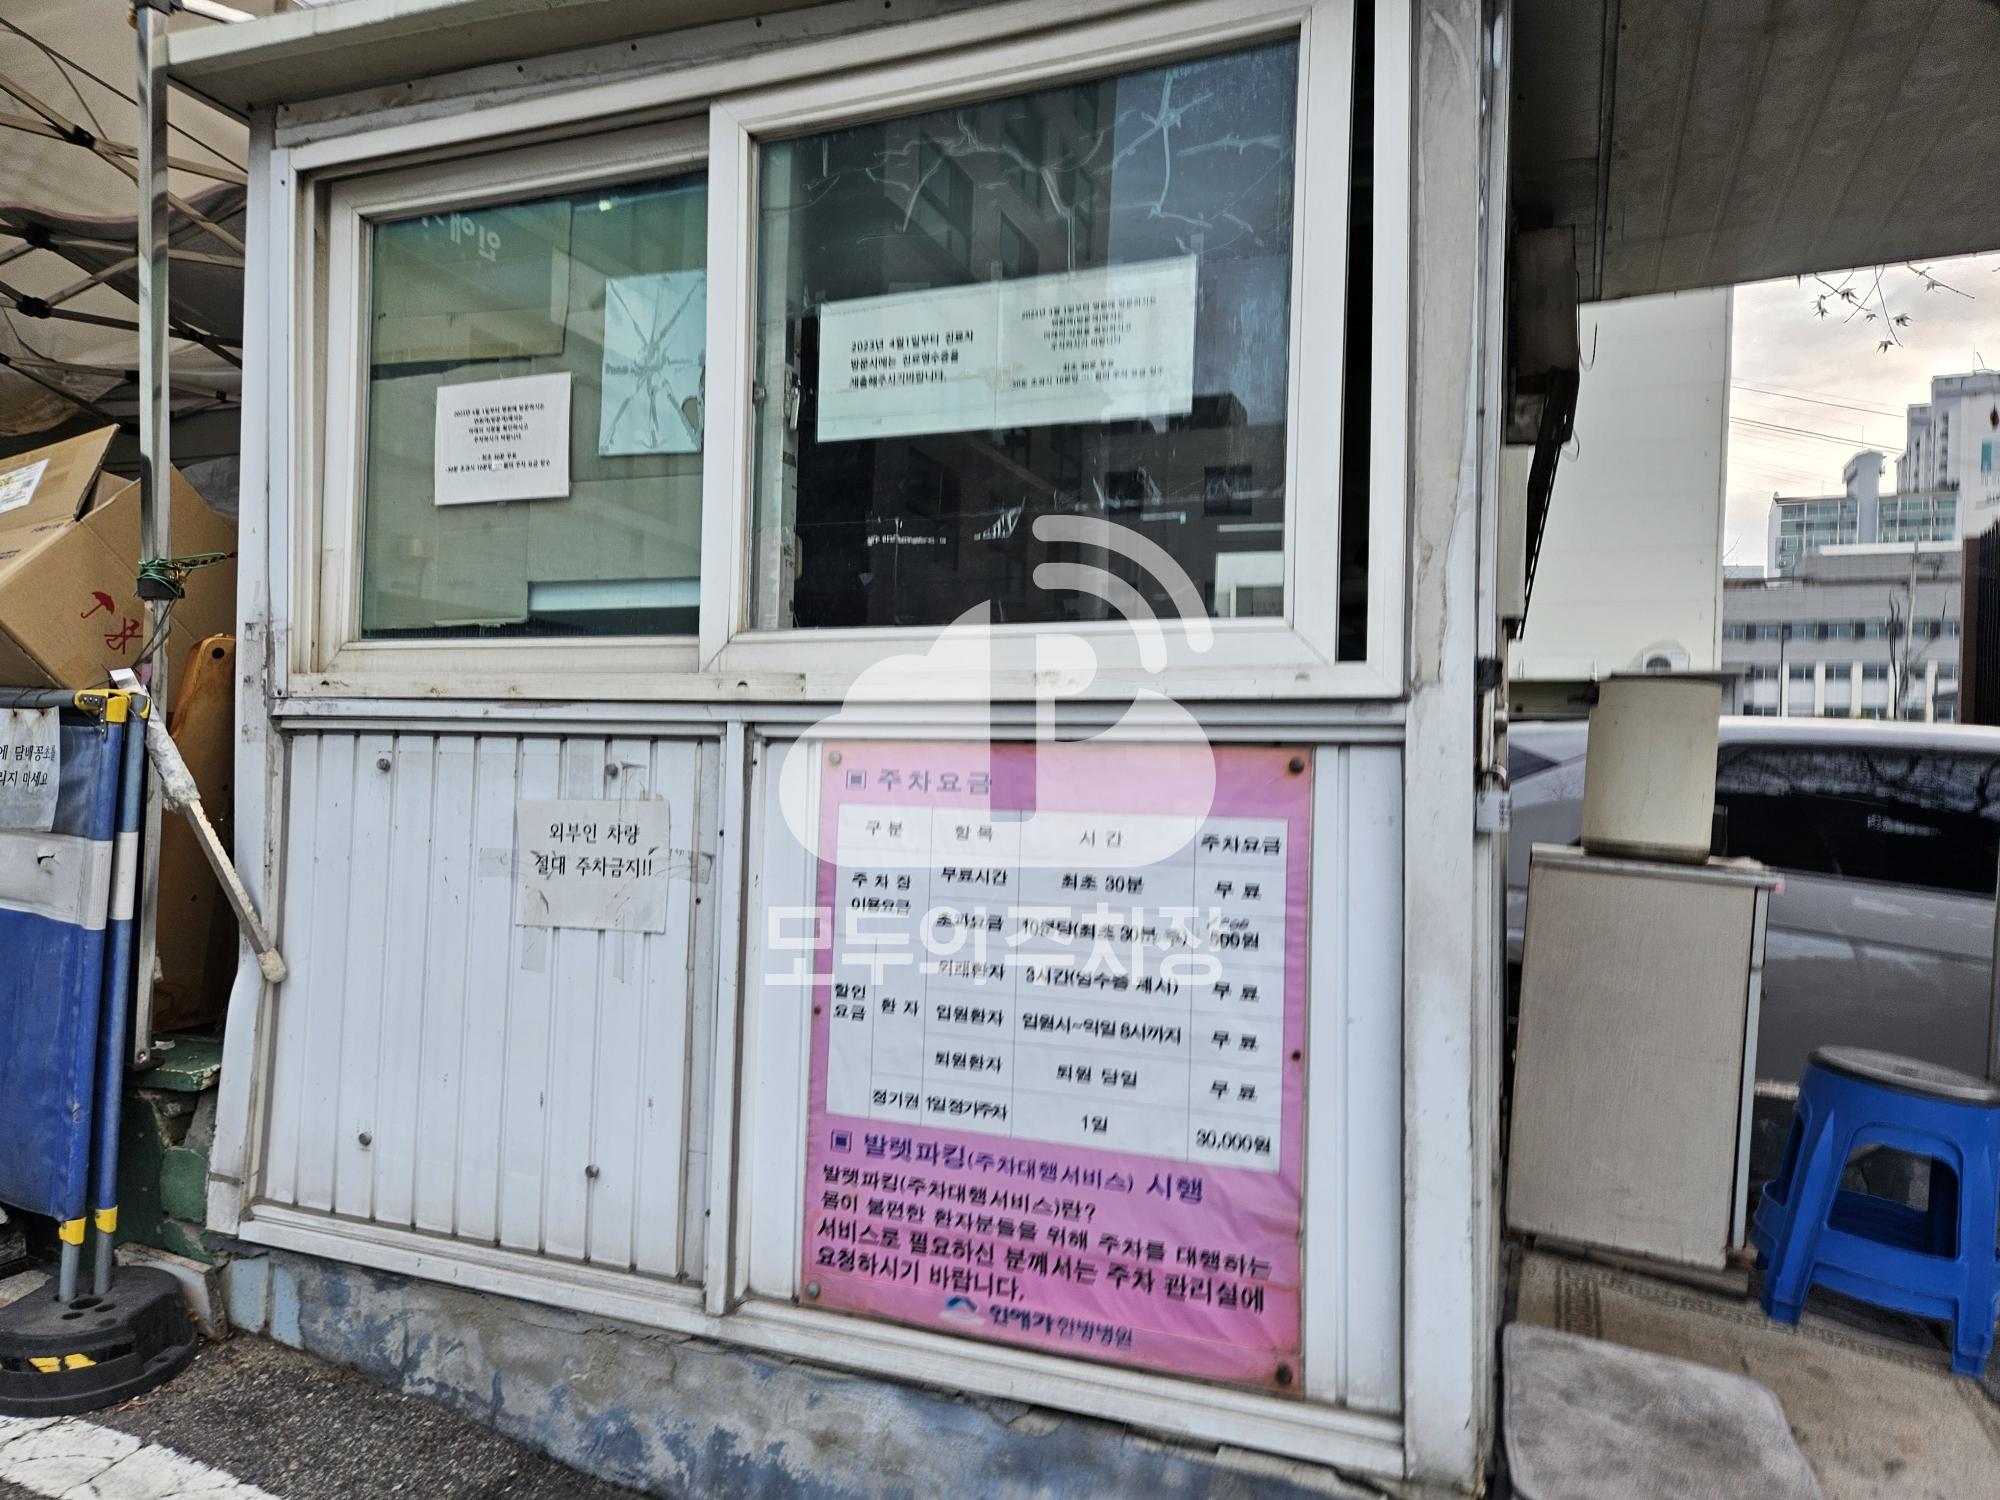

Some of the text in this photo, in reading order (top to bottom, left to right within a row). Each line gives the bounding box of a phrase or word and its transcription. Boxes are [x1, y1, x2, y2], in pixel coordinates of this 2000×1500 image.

[23, 770, 48, 786] 마세요
[878, 769, 992, 795] 주차요금
[549, 822, 639, 845] 외부인 차량
[1201, 833, 1282, 856] 주차요금
[535, 854, 652, 878] 절대 주차금지!!
[941, 867, 1008, 887] 무료시간
[1061, 872, 1098, 892] 최초
[1105, 874, 1145, 894] 30분
[834, 983, 866, 1001] 할인
[833, 1004, 866, 1022] 요금
[936, 1004, 1004, 1027] 입원환자
[934, 1050, 1002, 1074] 퇴원환자
[1056, 1064, 1092, 1084] 퇴원
[1101, 1068, 1138, 1090] 당일
[872, 1088, 920, 1111] 정기권
[1081, 1114, 1108, 1134] 1일
[1196, 1129, 1271, 1156] 30,000원
[1147, 1173, 1203, 1204] 시행
[821, 1190, 1272, 1280] 몸이 불편한 환자분들을 위해 주차를 대행하는
[816, 1245, 1025, 1302] 요청하시기 바랍니다.
[817, 1217, 1264, 1314] 서비스로 필요하신 분께서는 주차 관리실에
